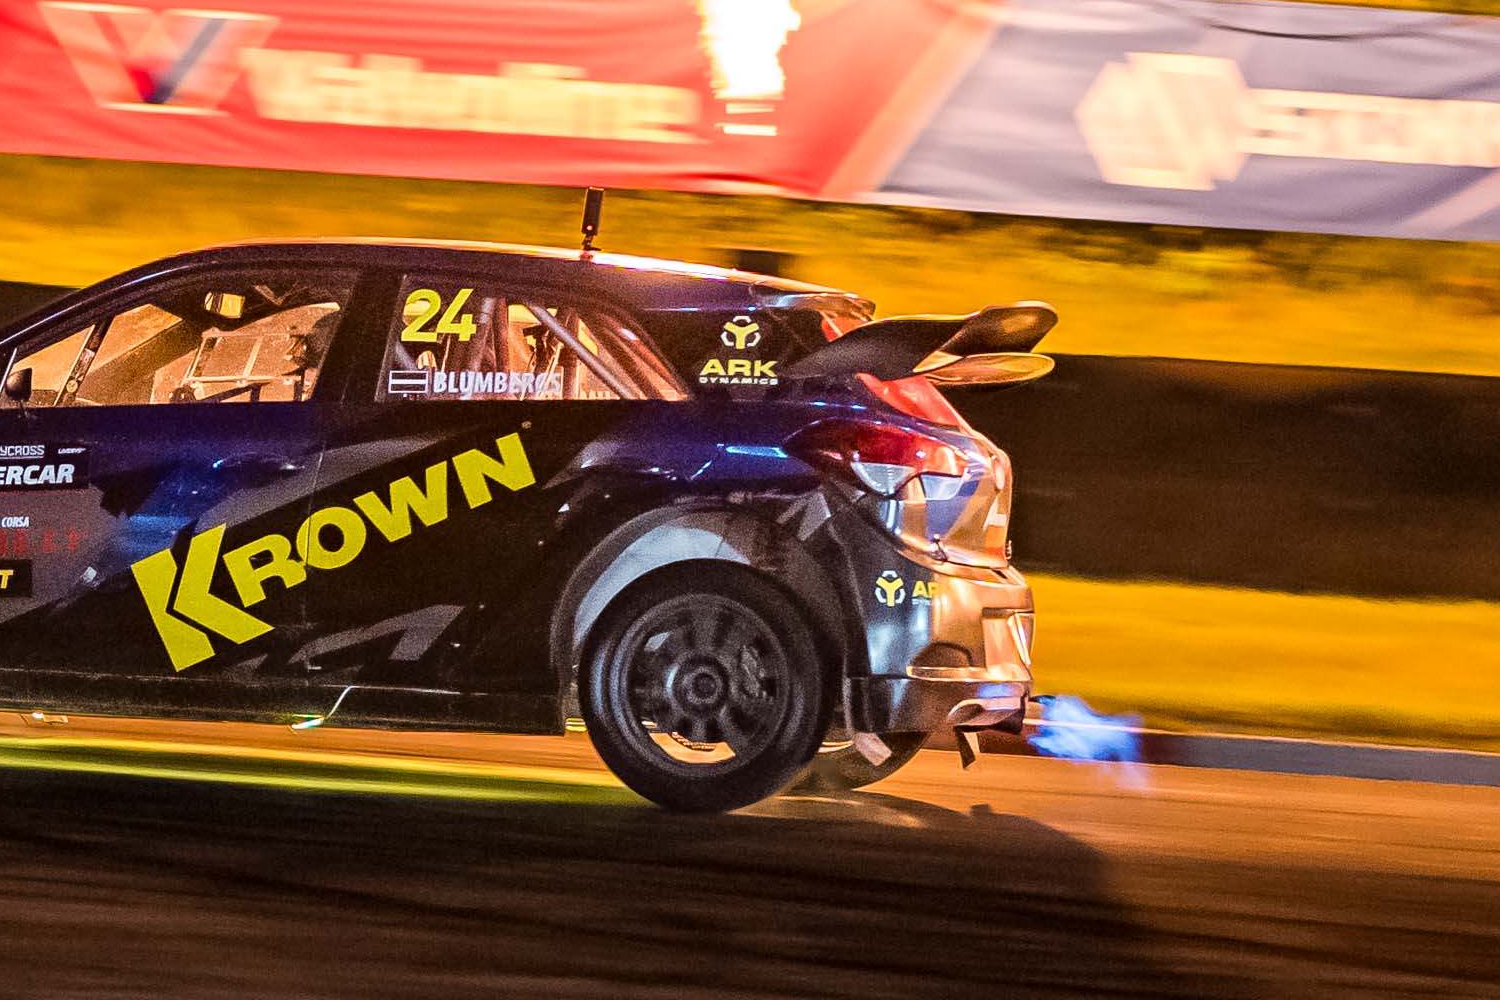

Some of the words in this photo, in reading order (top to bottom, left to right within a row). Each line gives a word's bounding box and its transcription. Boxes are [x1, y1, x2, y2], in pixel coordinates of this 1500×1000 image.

[400, 288, 477, 343] 24
[700, 358, 778, 377] ARK
[432, 371, 562, 395] BLUMBERGS
[699, 376, 779, 386] DYNAMICS
[1, 516, 30, 528] CORSA
[131, 432, 536, 672] KROWN
